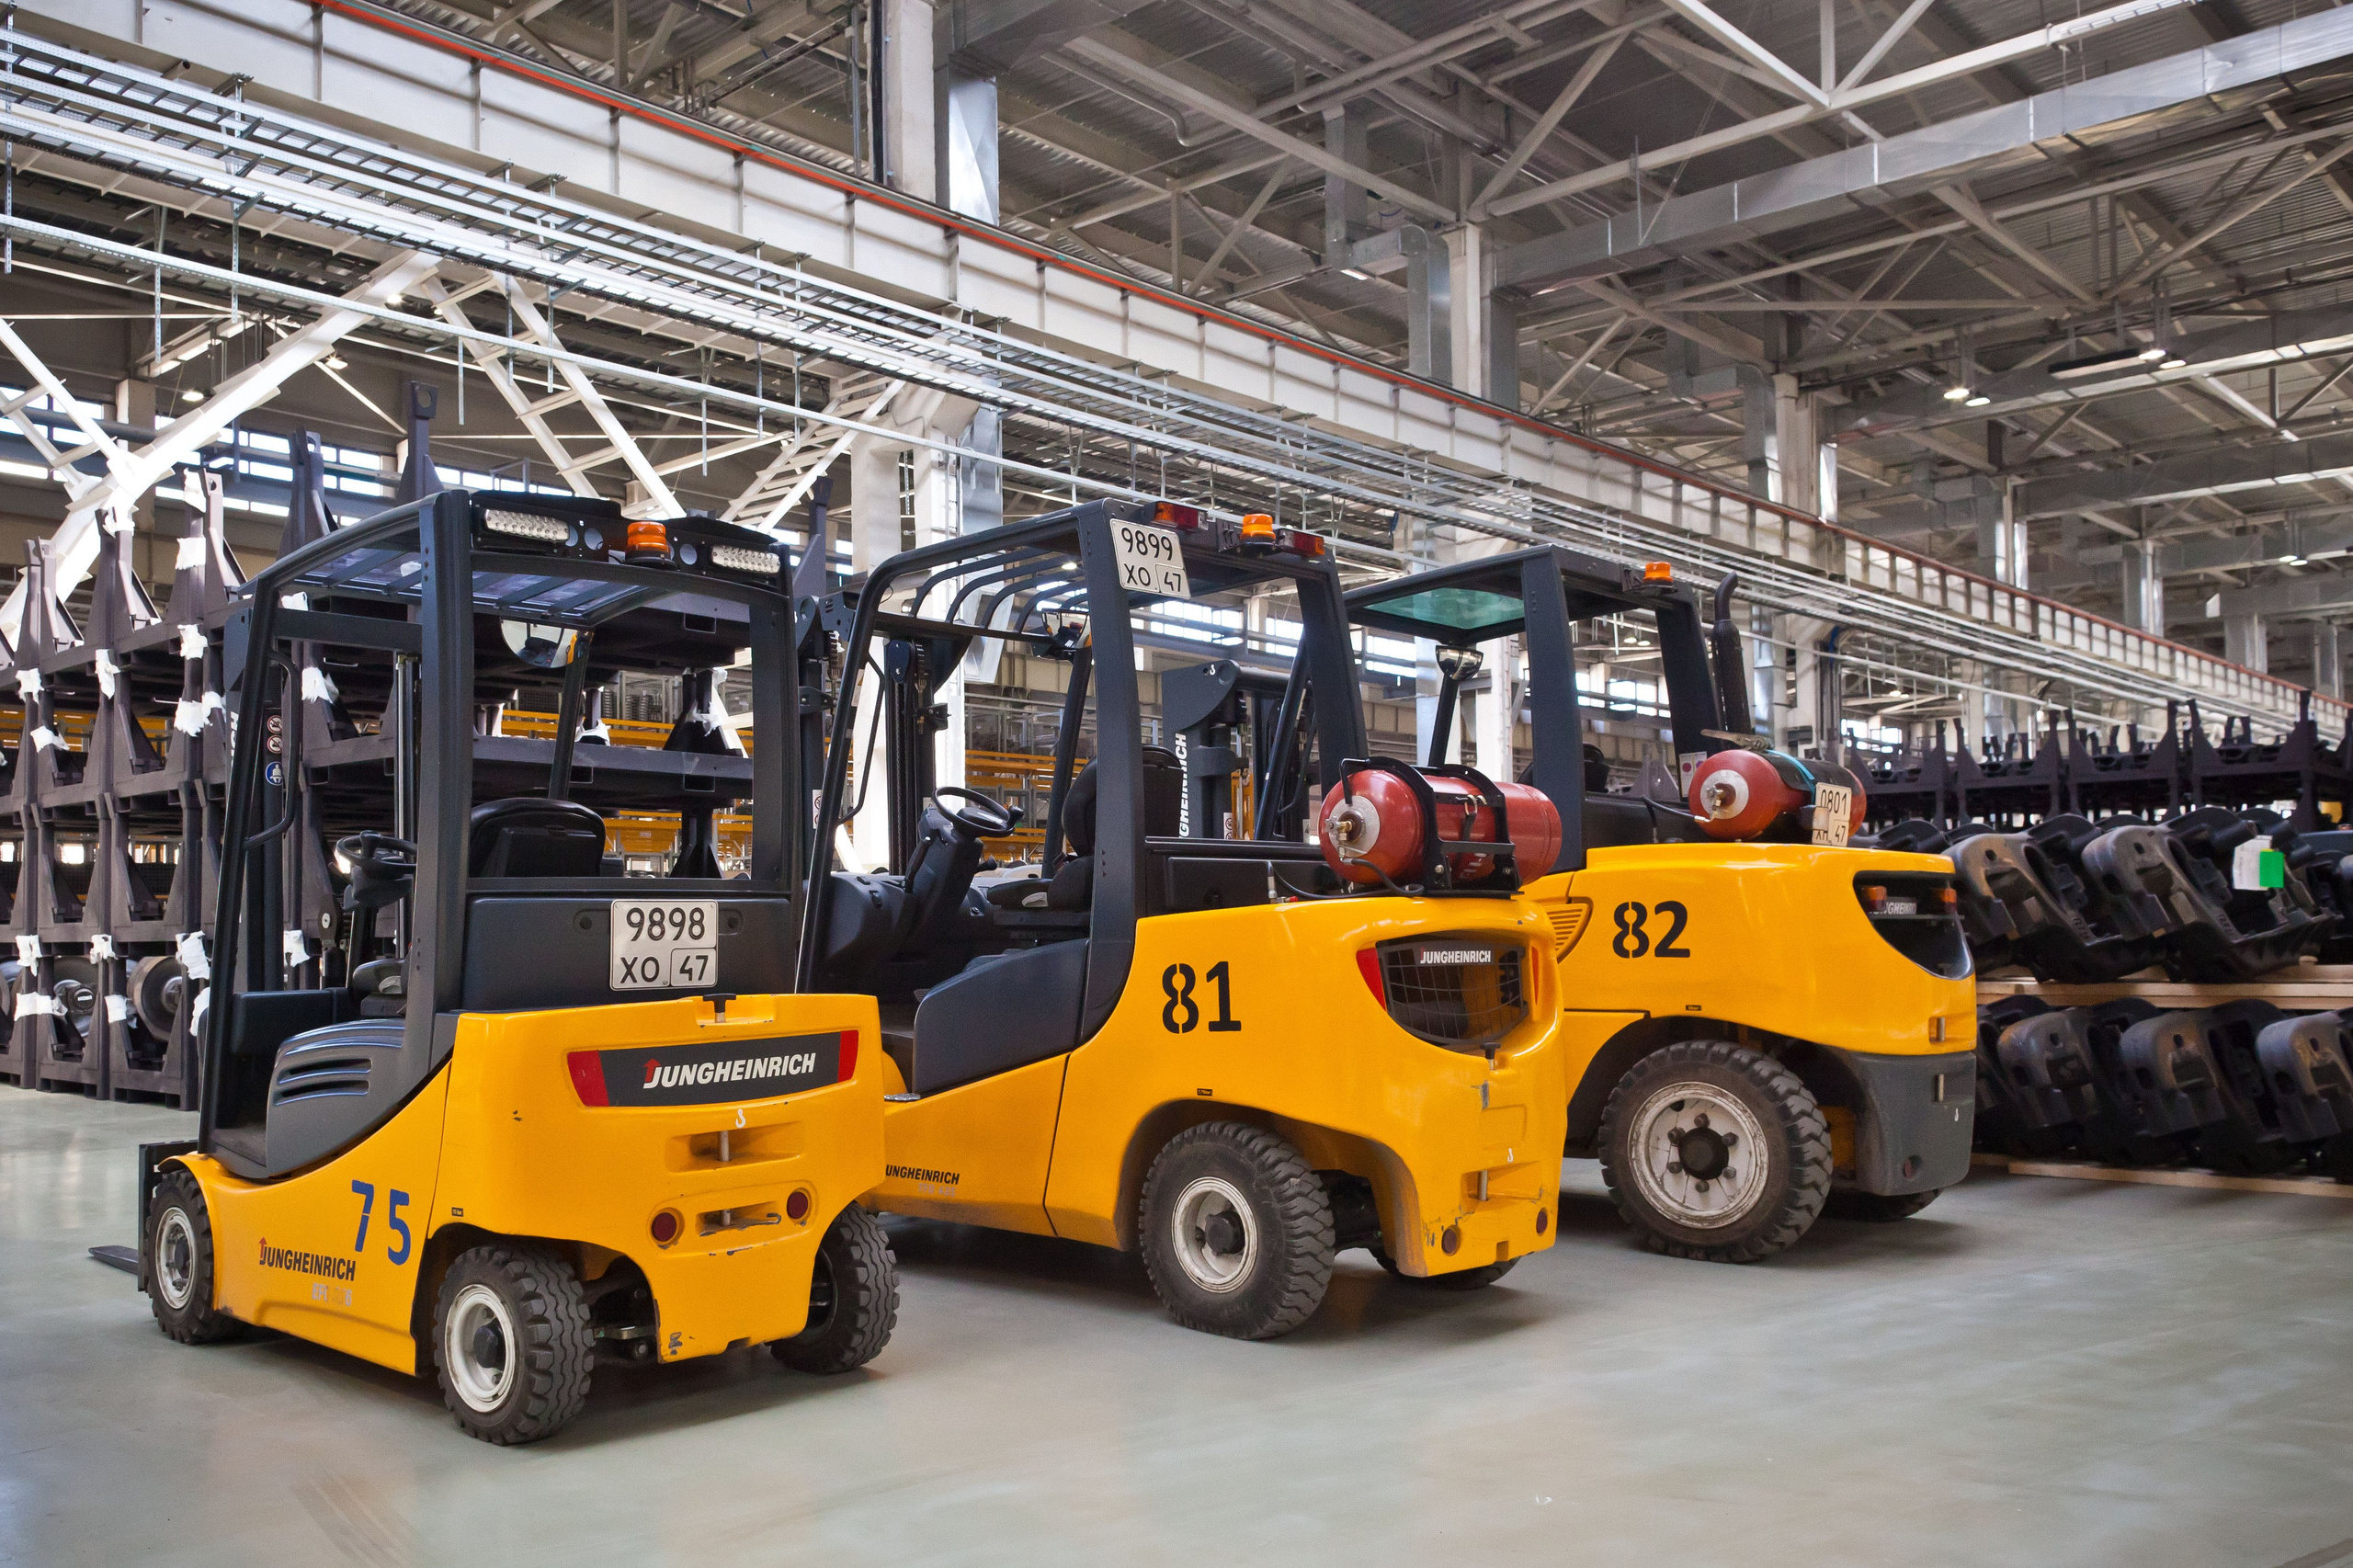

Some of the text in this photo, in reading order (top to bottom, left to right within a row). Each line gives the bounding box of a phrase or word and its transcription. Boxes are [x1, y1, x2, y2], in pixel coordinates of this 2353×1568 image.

[1120, 527, 1174, 561] 9899
[1164, 572, 1182, 593] 47
[1819, 789, 1847, 816] 0801
[1835, 824, 1847, 843] 47
[625, 906, 706, 942] 9898
[1612, 900, 1691, 959] 82
[678, 954, 710, 982] 47
[1420, 949, 1491, 964] JUNGHEINRICH
[1162, 960, 1242, 1034] 81
[642, 1052, 816, 1089] JUNGHEINRICH
[885, 1164, 961, 1185] UNGHEINRICH
[351, 1179, 412, 1266] 75
[258, 1245, 357, 1281] JUNGHEINRICH
